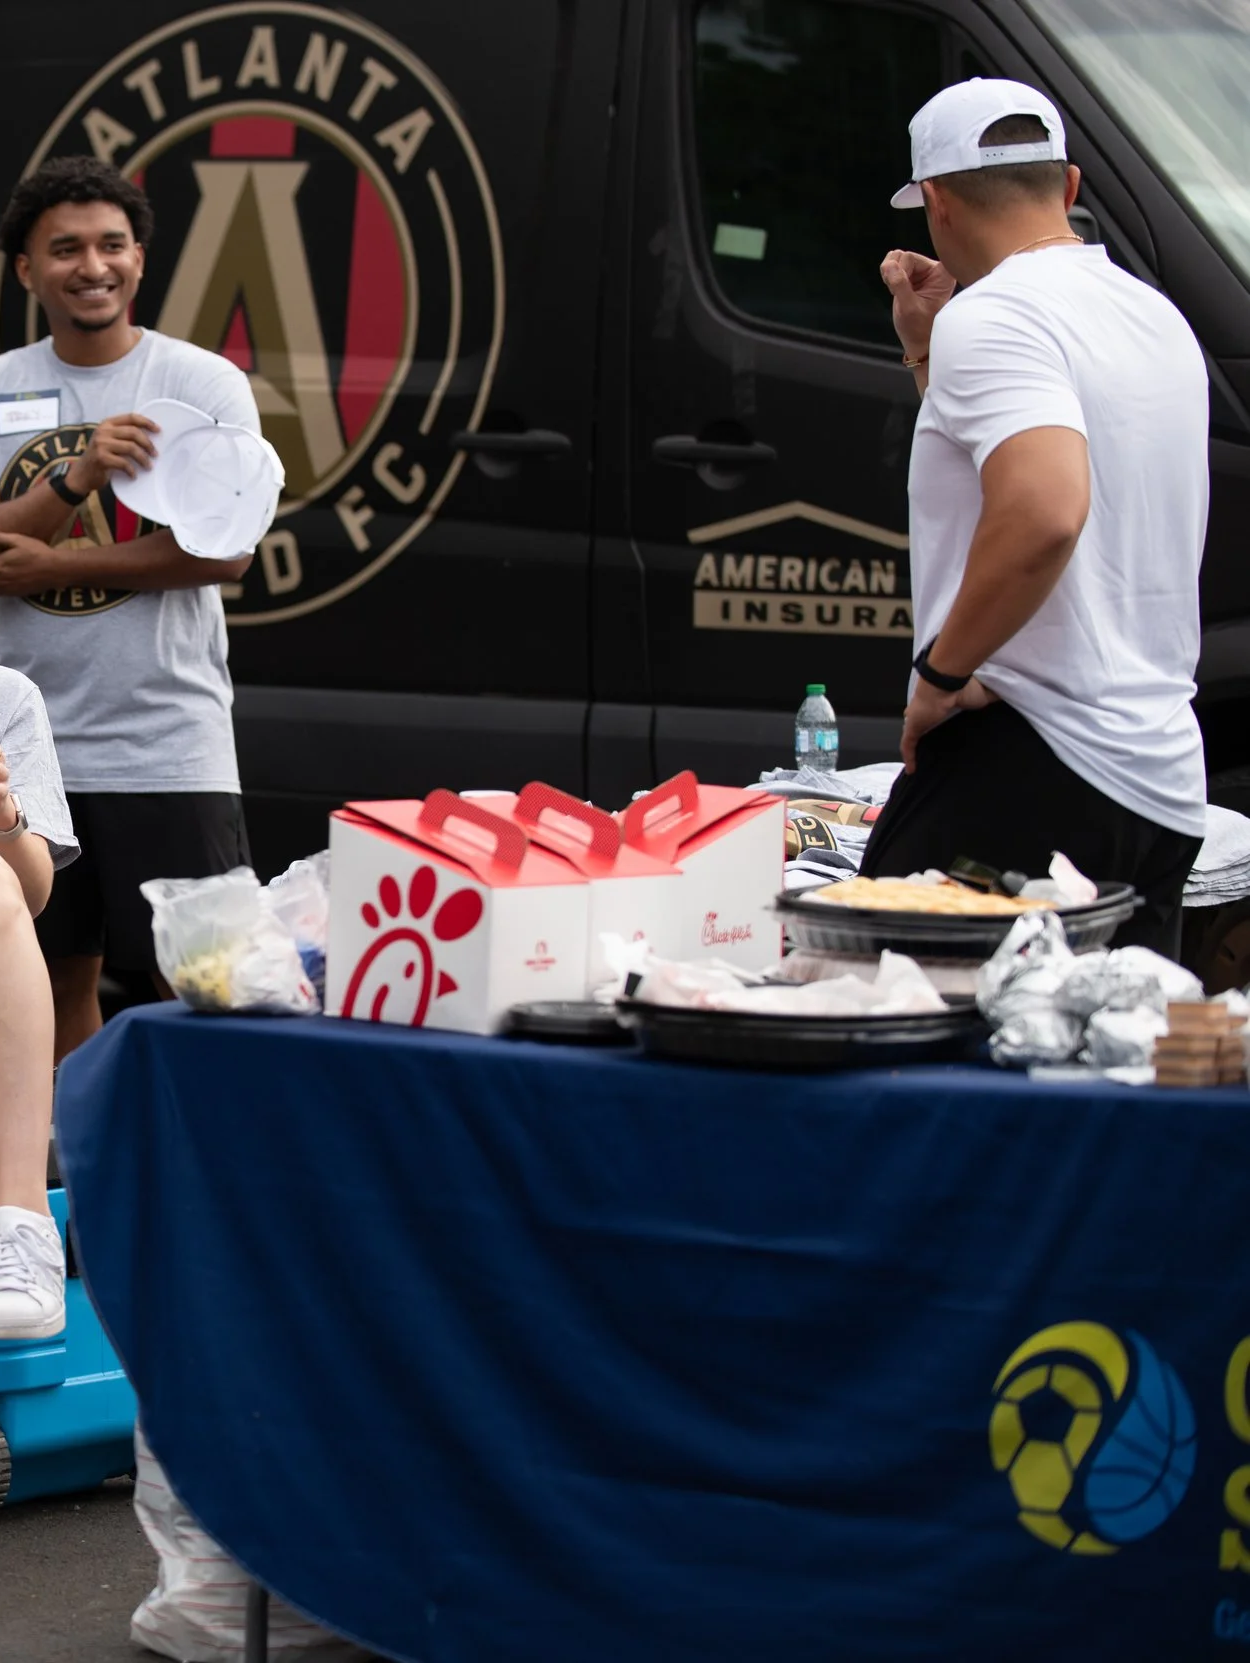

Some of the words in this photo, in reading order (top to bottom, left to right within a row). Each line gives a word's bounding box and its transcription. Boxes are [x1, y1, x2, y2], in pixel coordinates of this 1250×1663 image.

[82, 26, 434, 174] ATLANTA
[18, 432, 88, 479] ATLA
[333, 442, 427, 553] FC
[694, 552, 897, 595] AMERICAN
